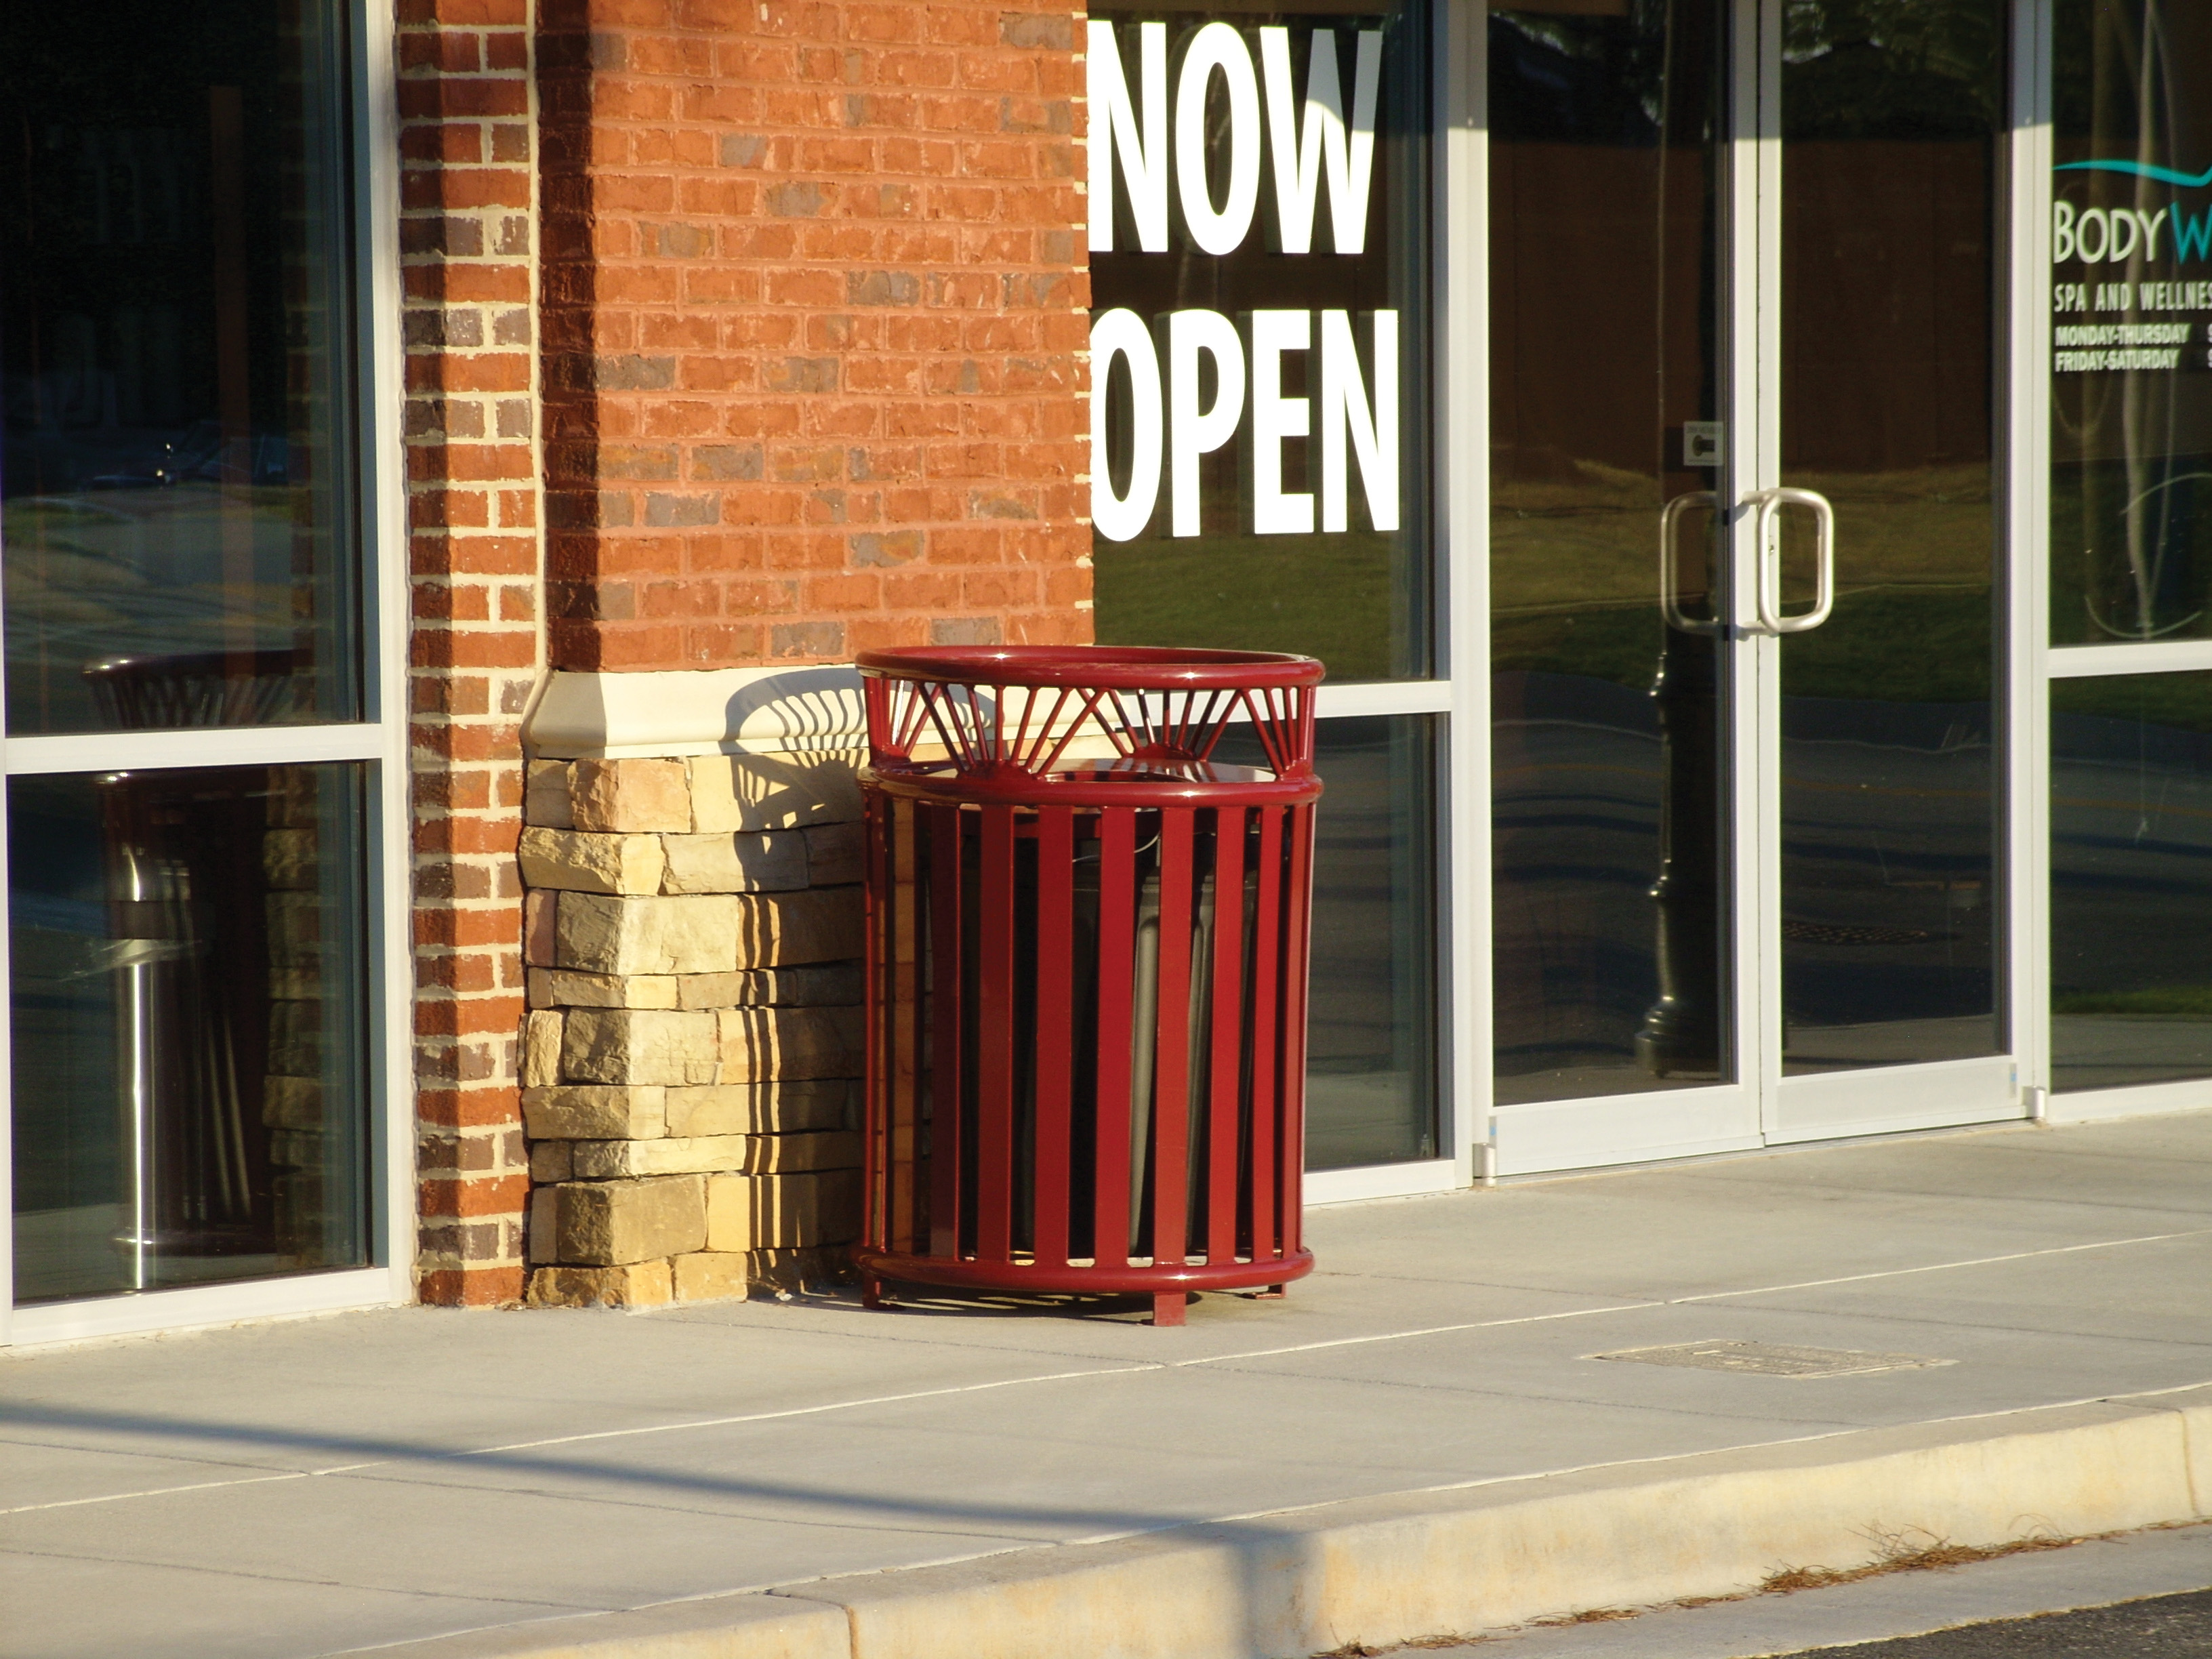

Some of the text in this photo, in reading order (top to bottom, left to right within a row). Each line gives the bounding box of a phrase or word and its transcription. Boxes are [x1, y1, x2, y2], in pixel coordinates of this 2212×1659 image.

[1087, 20, 1383, 255] NOW
[2054, 283, 2087, 312] SPA
[2095, 282, 2133, 311] AND
[2055, 323, 2191, 346] MONDAY-THURSDAY
[2055, 348, 2180, 372] FRIDAY-SATURDAY
[1090, 308, 1400, 541] OPEN
